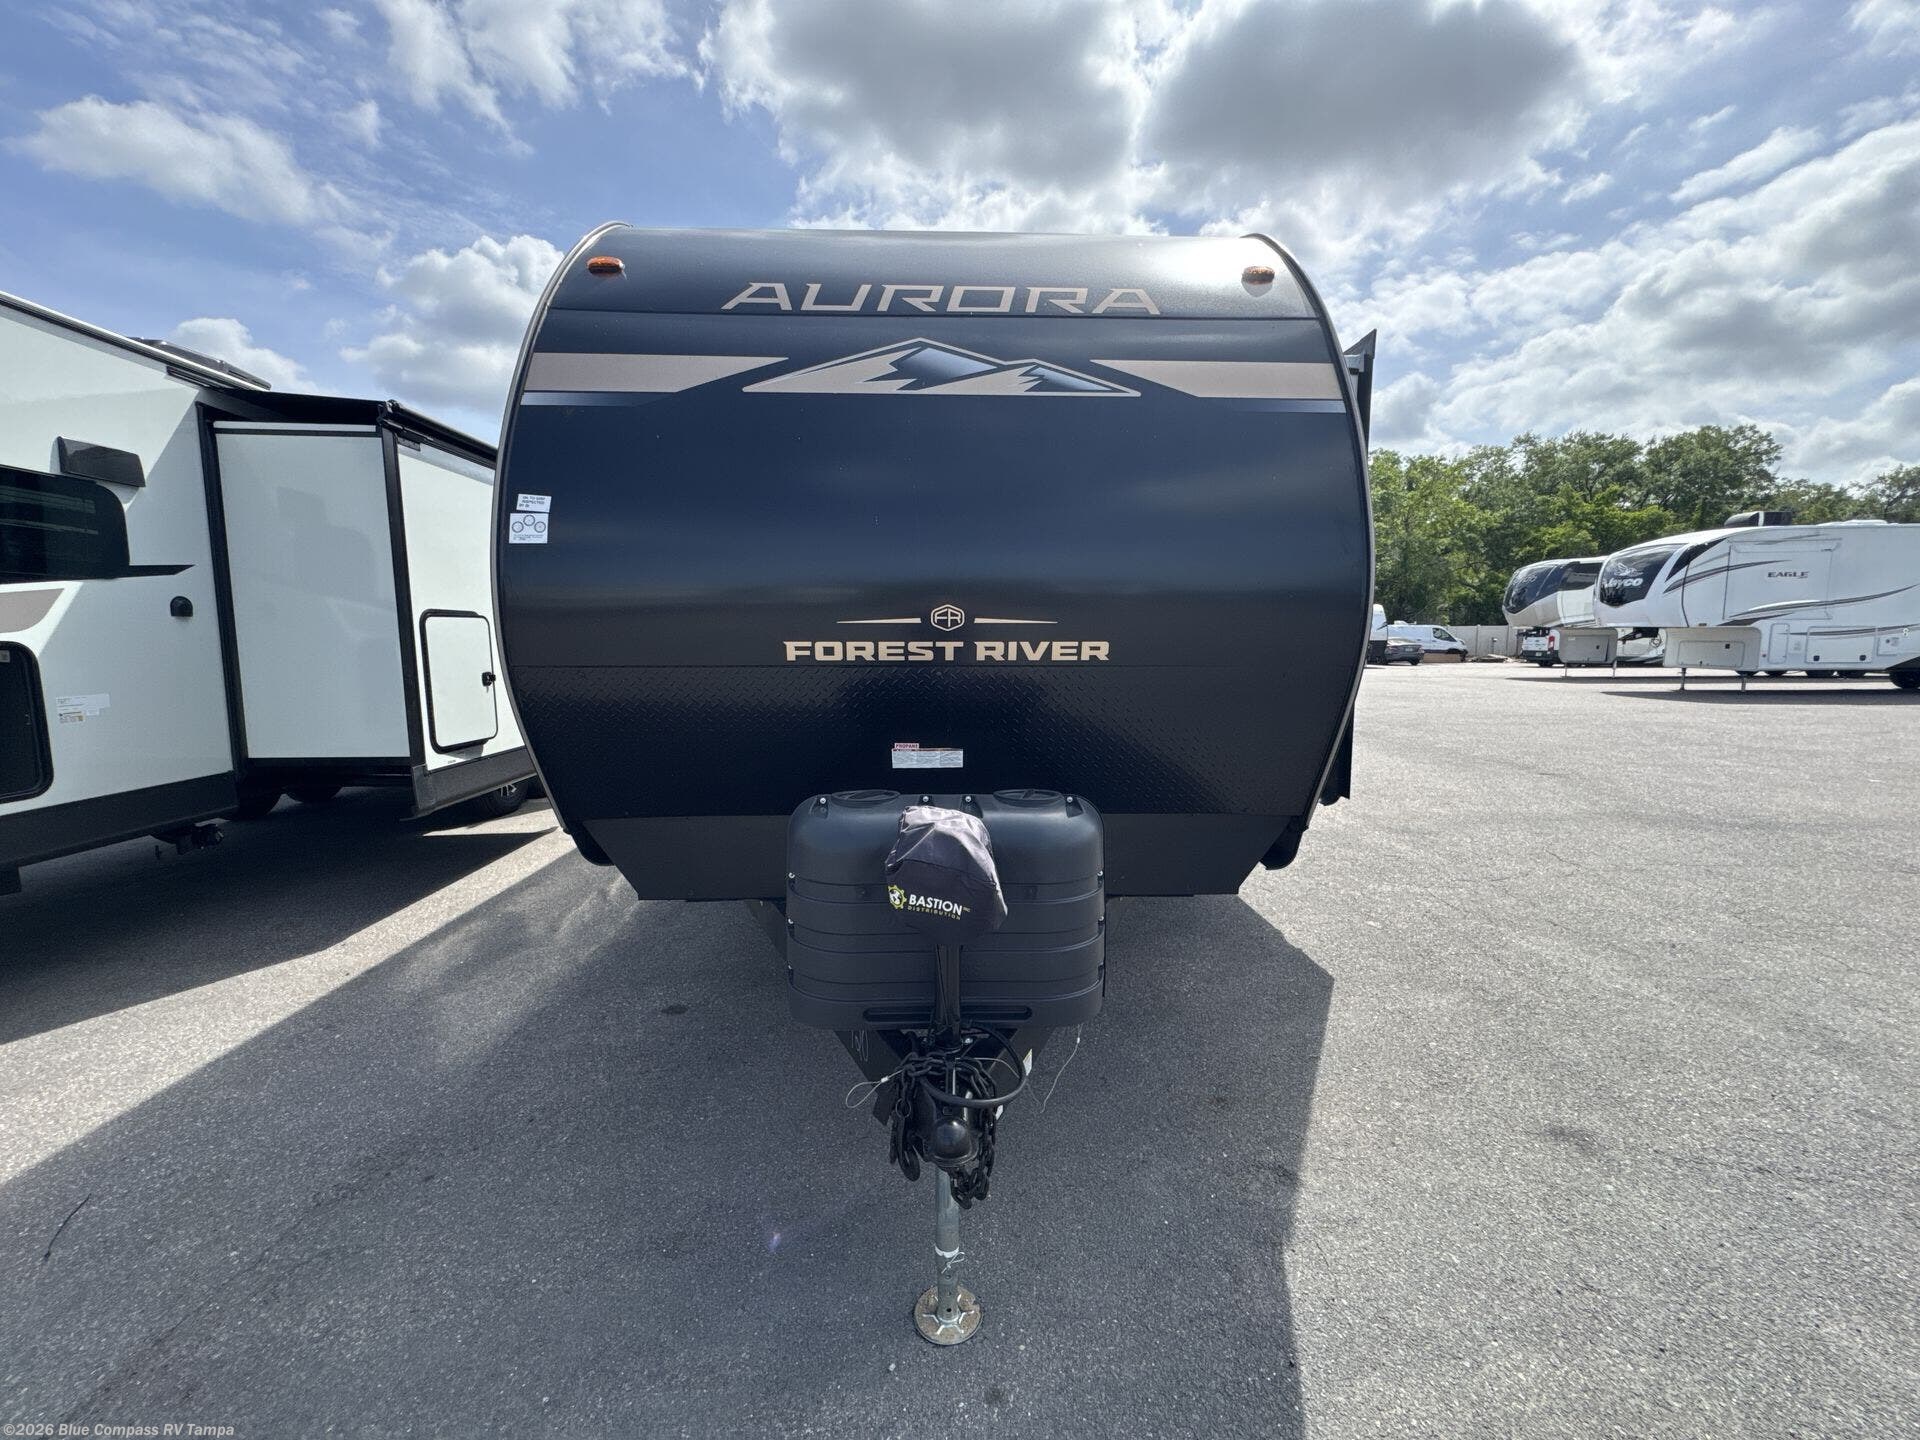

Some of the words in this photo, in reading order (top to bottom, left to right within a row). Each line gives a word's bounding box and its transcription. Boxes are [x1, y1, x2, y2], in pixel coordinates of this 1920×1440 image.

[720, 282, 1161, 316] AURORA
[783, 640, 964, 661] FOREST
[973, 640, 1110, 661] RIVER
[908, 906, 961, 921] DISTRIBUTION
[909, 894, 962, 916] BASTION
